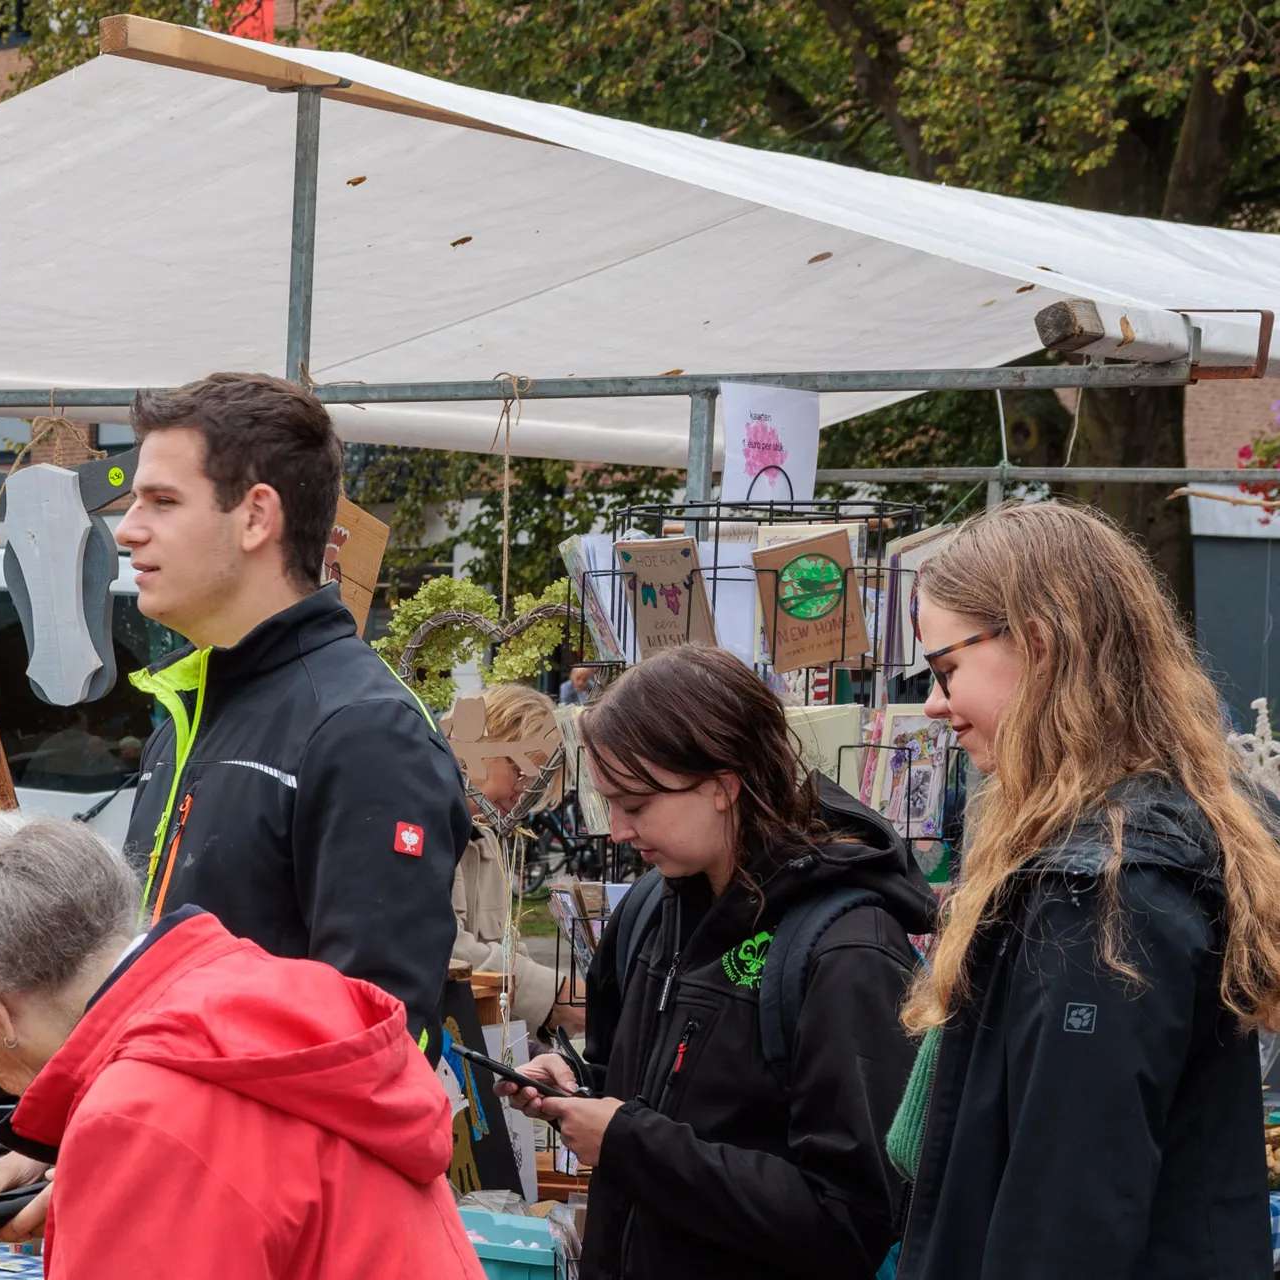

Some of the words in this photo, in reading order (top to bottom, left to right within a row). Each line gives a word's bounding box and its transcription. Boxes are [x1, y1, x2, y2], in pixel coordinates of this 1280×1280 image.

[749, 410, 773, 422] kaarten
[747, 441, 761, 449] euro
[761, 442, 772, 452] per
[772, 443, 785, 452] stuk
[634, 555, 679, 568] HOERA
[654, 620, 679, 630] een
[776, 625, 810, 646] NEW
[721, 952, 738, 982] COUTING
